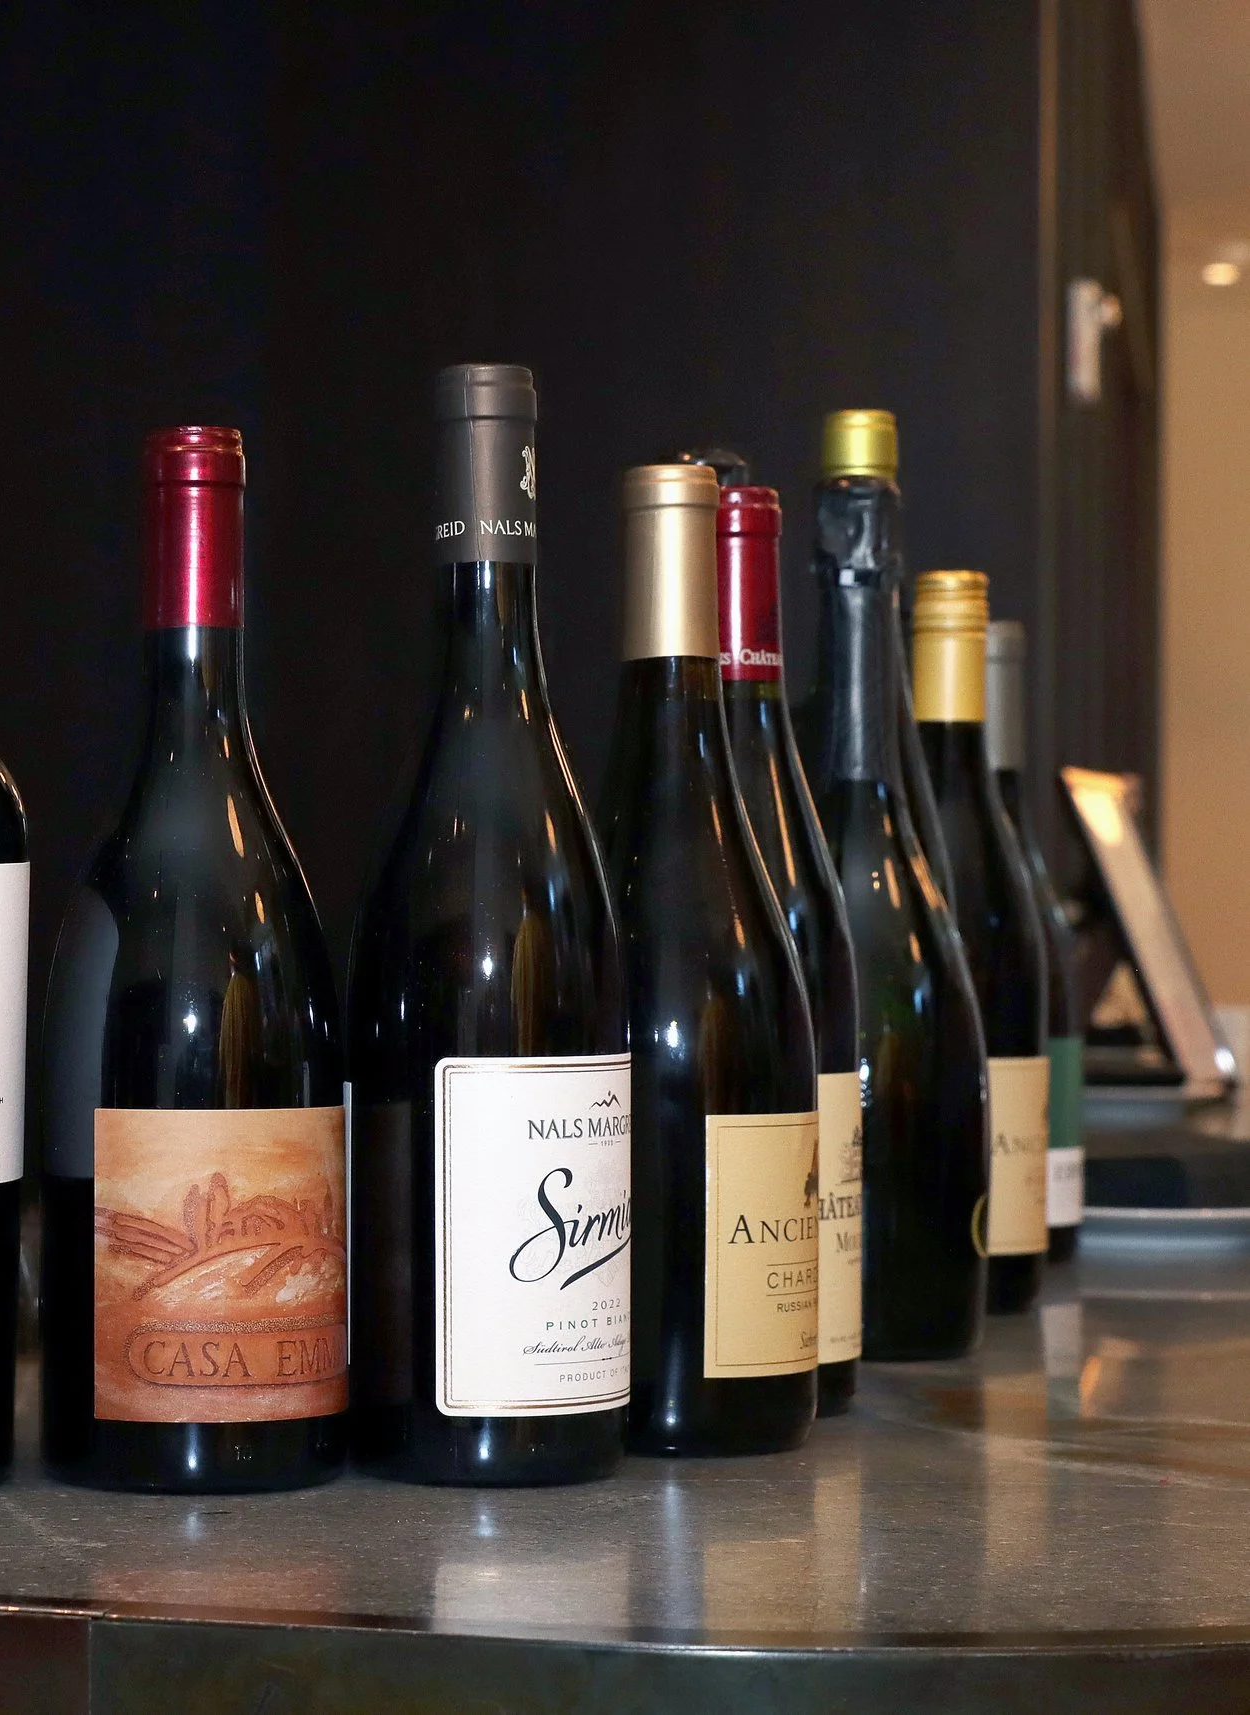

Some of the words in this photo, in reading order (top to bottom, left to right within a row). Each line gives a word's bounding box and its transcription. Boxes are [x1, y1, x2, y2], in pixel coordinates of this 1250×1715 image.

[480, 519, 522, 536] NALS
[527, 1118, 584, 1140] NALS
[587, 1114, 631, 1138] MARGR
[591, 1298, 622, 1311] 2022
[546, 1318, 598, 1331] PINOT
[522, 1335, 586, 1355] Südtirol
[143, 1339, 251, 1378] CASA
[558, 1370, 607, 1383] PRODUCT
